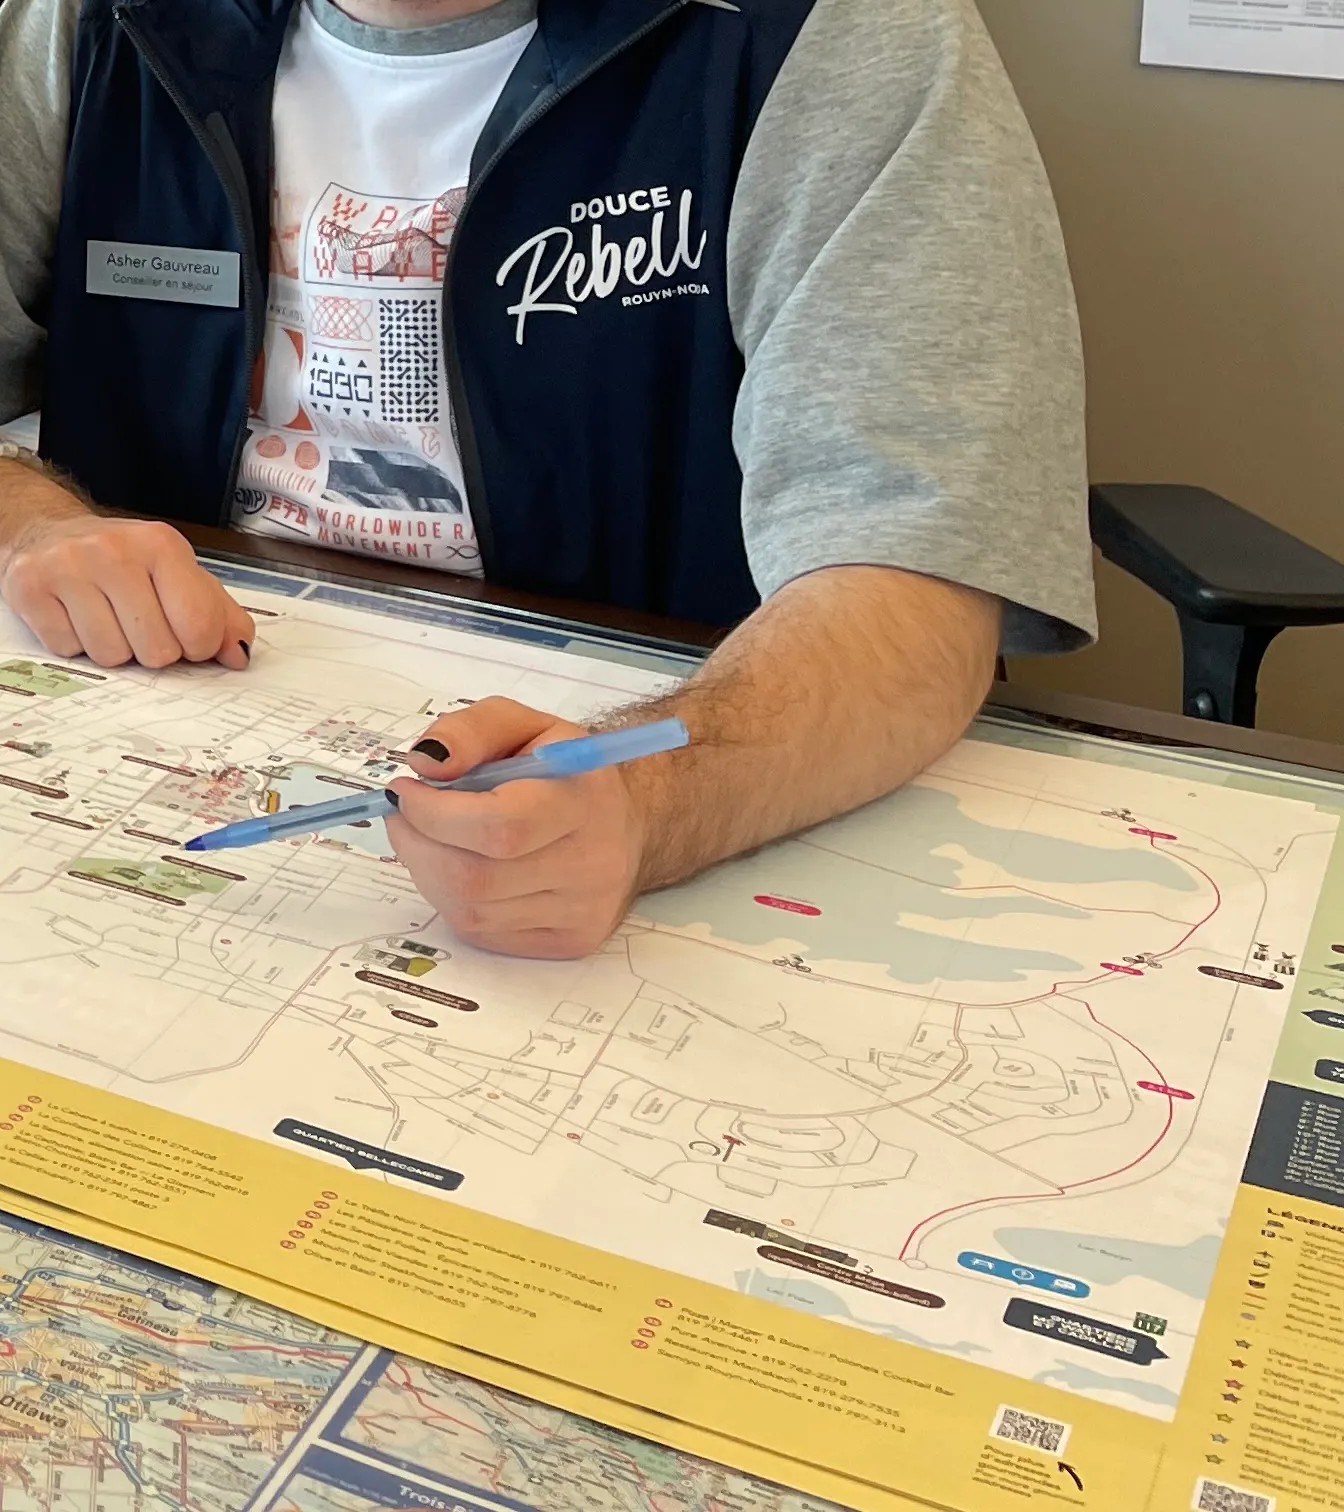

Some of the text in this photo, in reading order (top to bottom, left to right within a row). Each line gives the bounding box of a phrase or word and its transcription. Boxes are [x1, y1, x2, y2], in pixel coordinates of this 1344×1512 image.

[570, 186, 671, 223] DOUCE
[107, 253, 220, 276] Asher Gauvreau
[496, 189, 707, 345] Rebell
[316, 507, 441, 539] WORLDWIDE
[318, 528, 432, 559] MOVEMENT
[292, 1128, 444, 1181] QUARTIER BELLECOMBE
[129, 1185, 159, 1199] poste
[302, 1248, 332, 1262] Olive
[311, 1238, 350, 1255] Moulin
[351, 1251, 376, 1264] Noir
[117, 1308, 178, 1337] Gatineau
[703, 1322, 758, 1344] 797-4461
[1133, 1320, 1161, 1333] 117
[662, 1337, 729, 1363] Restaurant
[669, 1325, 698, 1339] Pure
[701, 1336, 747, 1355] Avenue
[59, 1359, 105, 1381] Vanier
[718, 1318, 763, 1337] Manger
[881, 1370, 930, 1391] Cocktail
[932, 1387, 956, 1398] Bar
[704, 1364, 803, 1400] Rouyn-Noranda
[0, 1394, 69, 1428] Ottawa
[984, 1445, 1013, 1458] Pour
